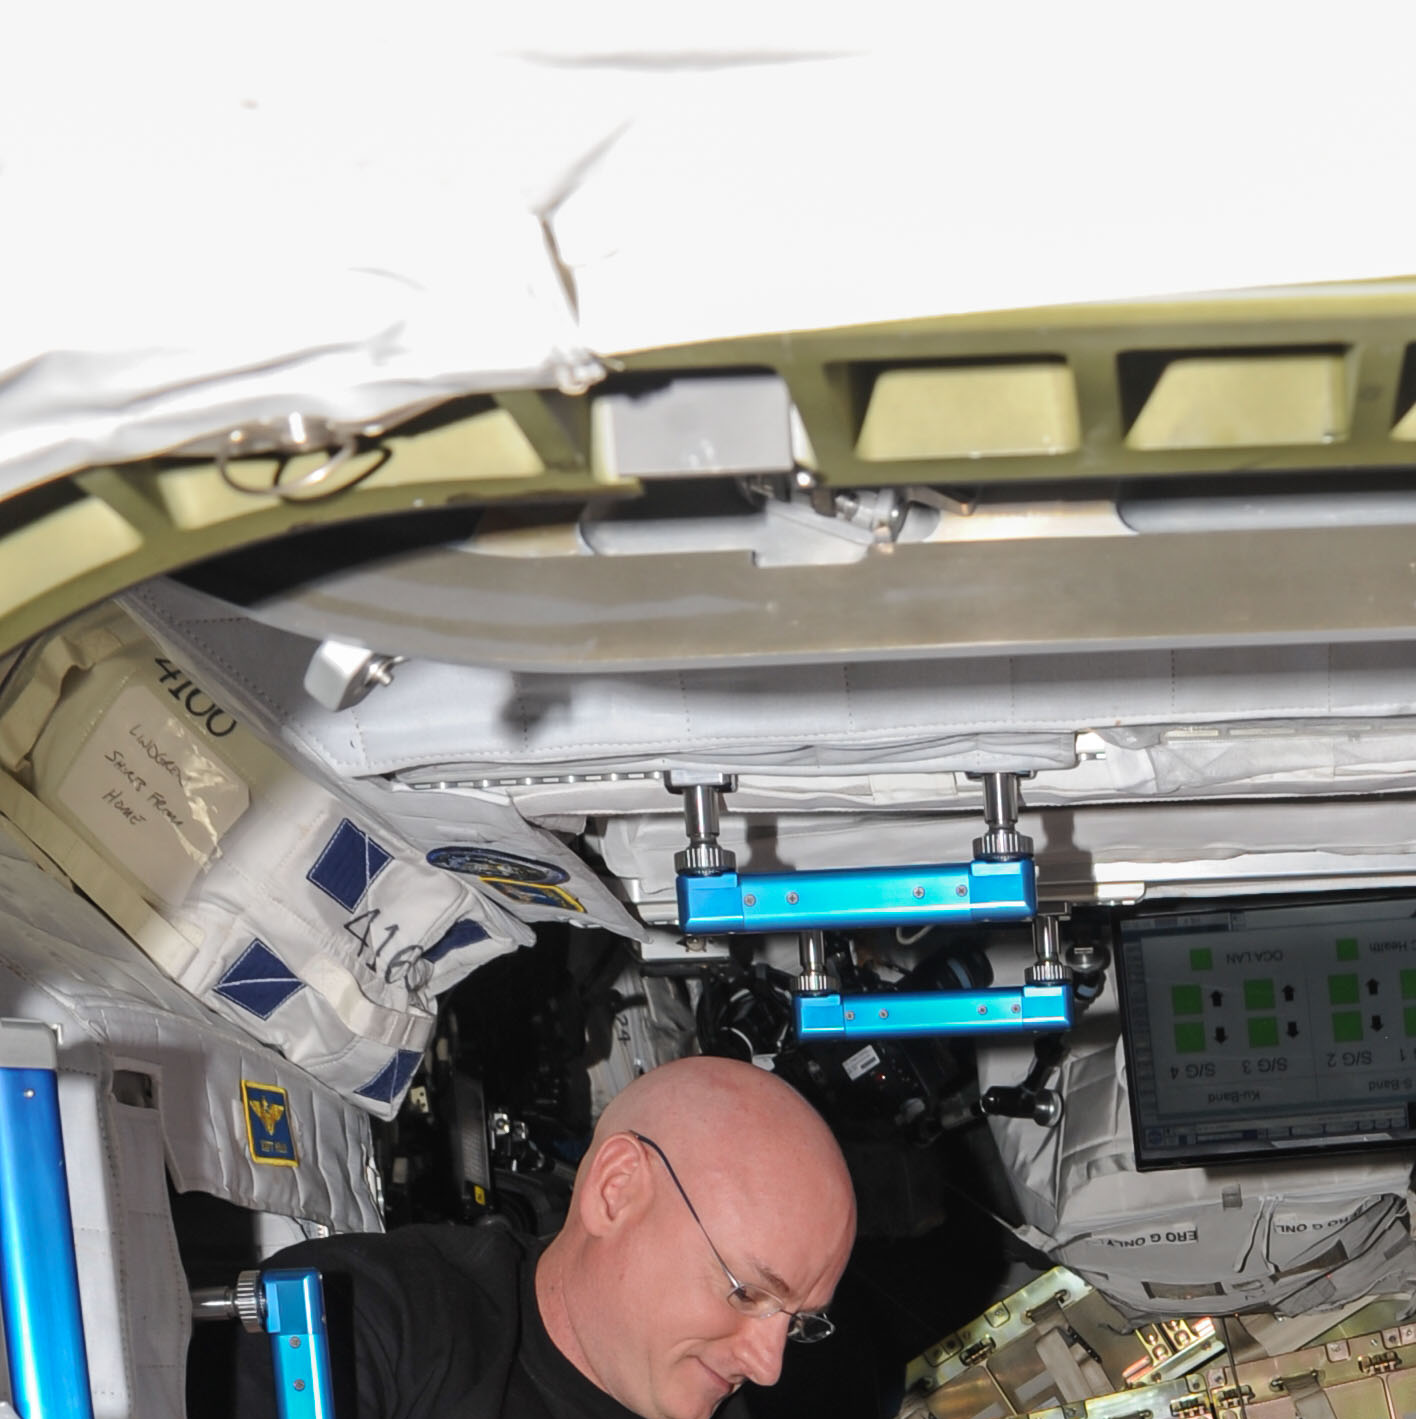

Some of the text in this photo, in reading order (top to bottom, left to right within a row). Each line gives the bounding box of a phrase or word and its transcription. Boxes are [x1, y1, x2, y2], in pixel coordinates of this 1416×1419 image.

[1258, 1057, 1288, 1073] S/G
[1327, 1050, 1373, 1067] S/G 2
[1170, 1062, 1216, 1079] S/G 4
